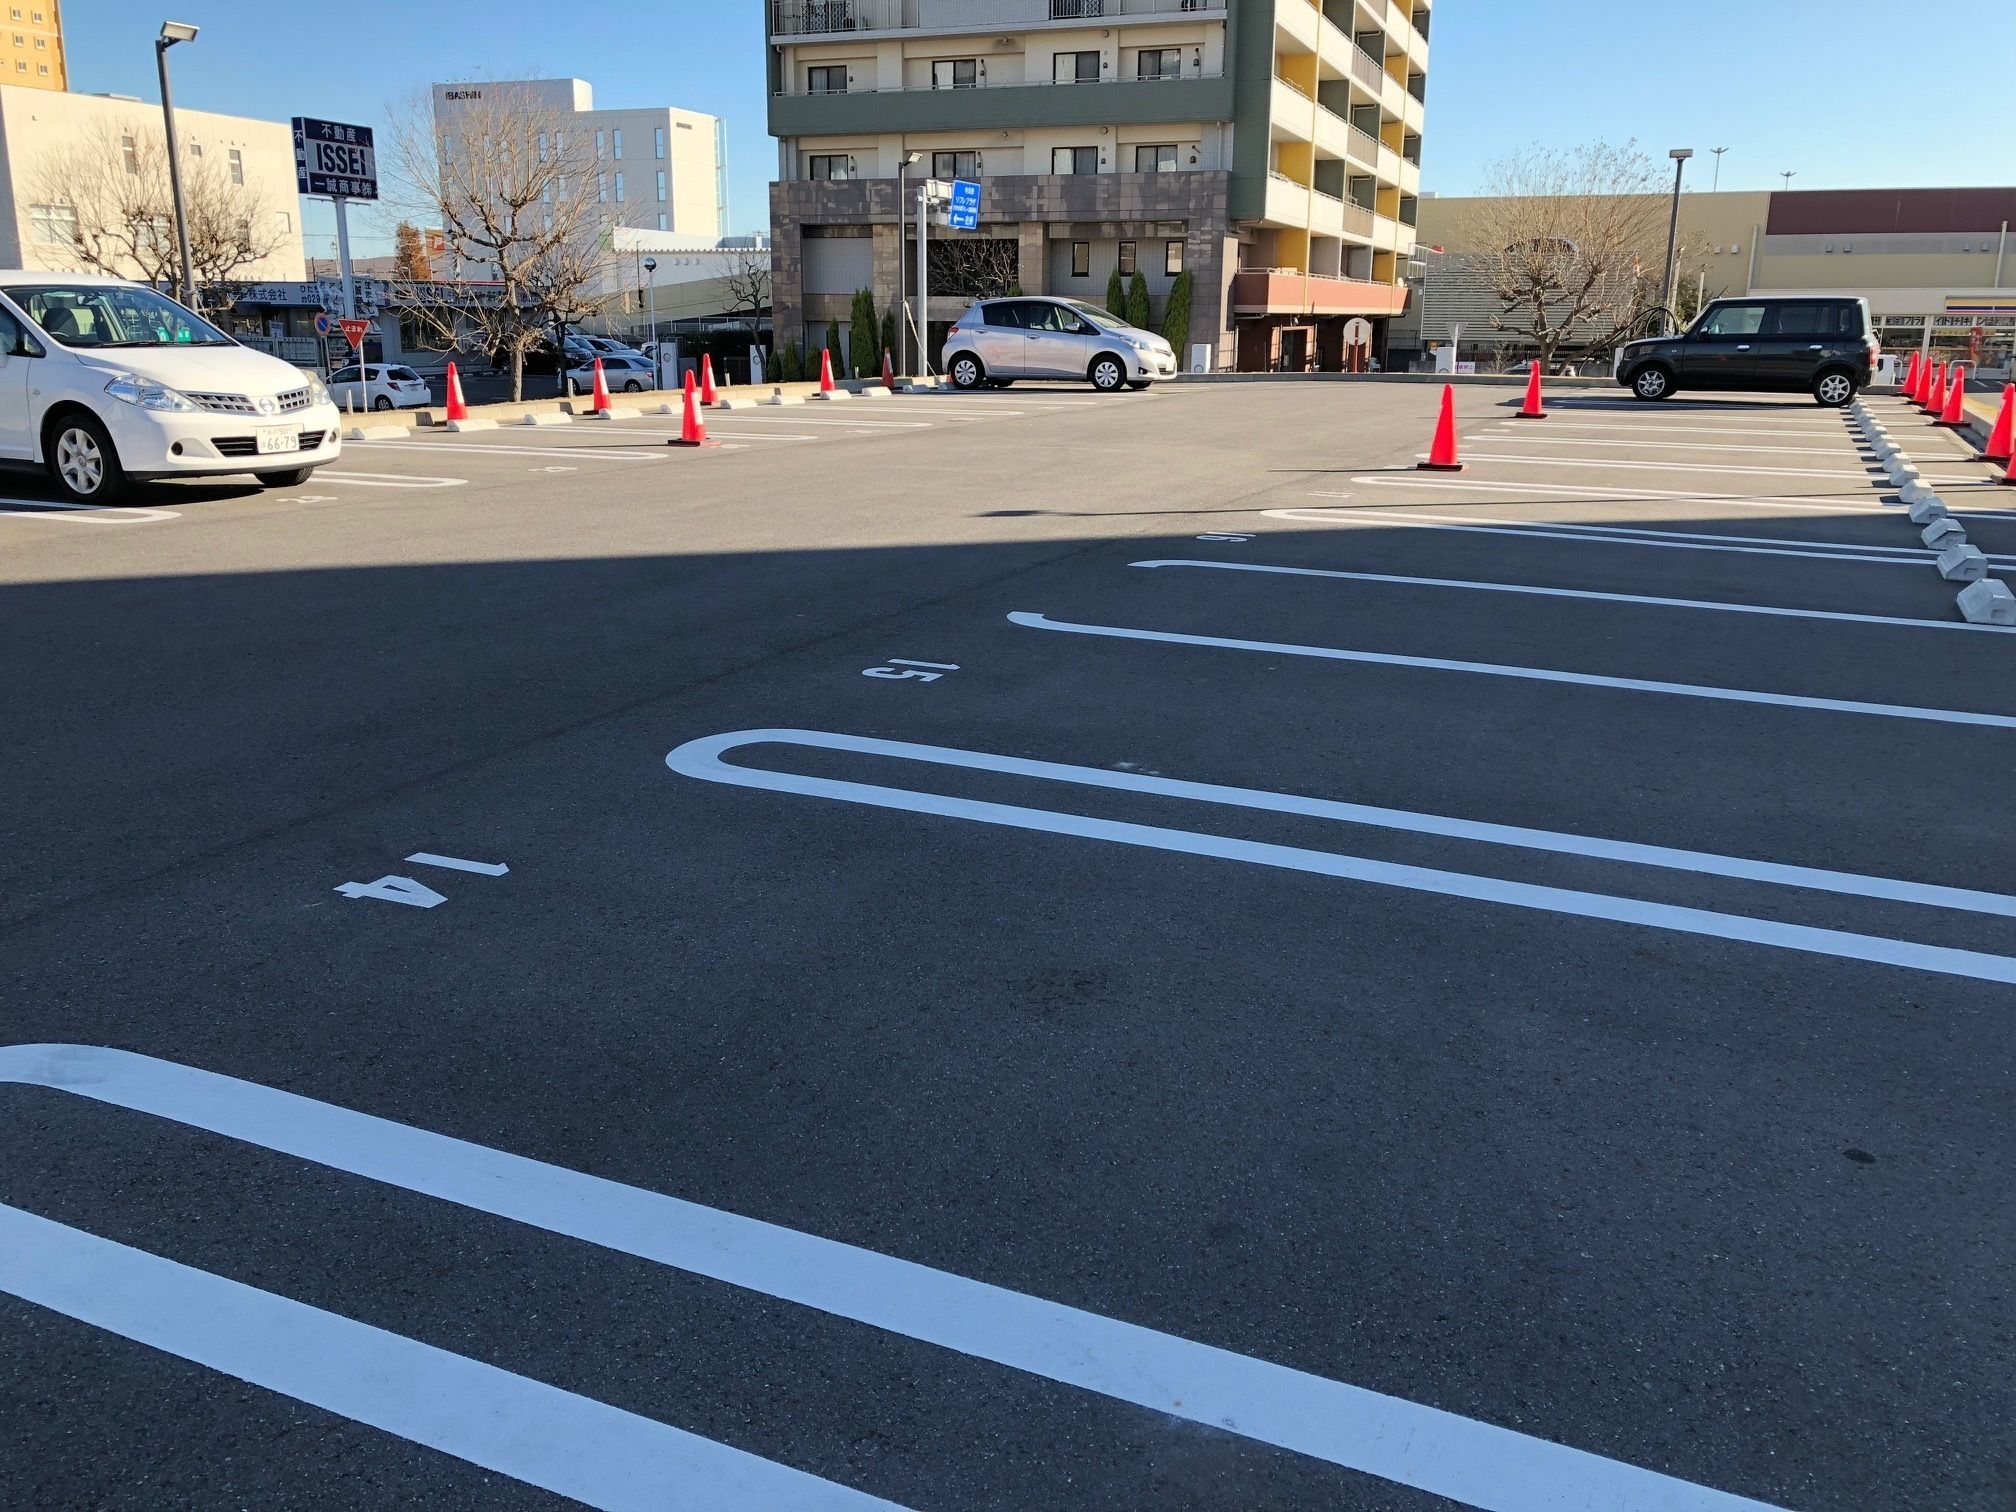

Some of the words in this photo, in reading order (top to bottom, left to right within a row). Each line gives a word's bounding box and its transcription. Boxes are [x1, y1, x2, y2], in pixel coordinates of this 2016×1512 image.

[321, 123, 357, 142] 不動産
[294, 130, 307, 178] 不動産
[316, 142, 367, 176] ISSEI
[345, 325, 363, 333] 止まれ
[862, 658, 961, 682] 15
[333, 852, 510, 909] 14
